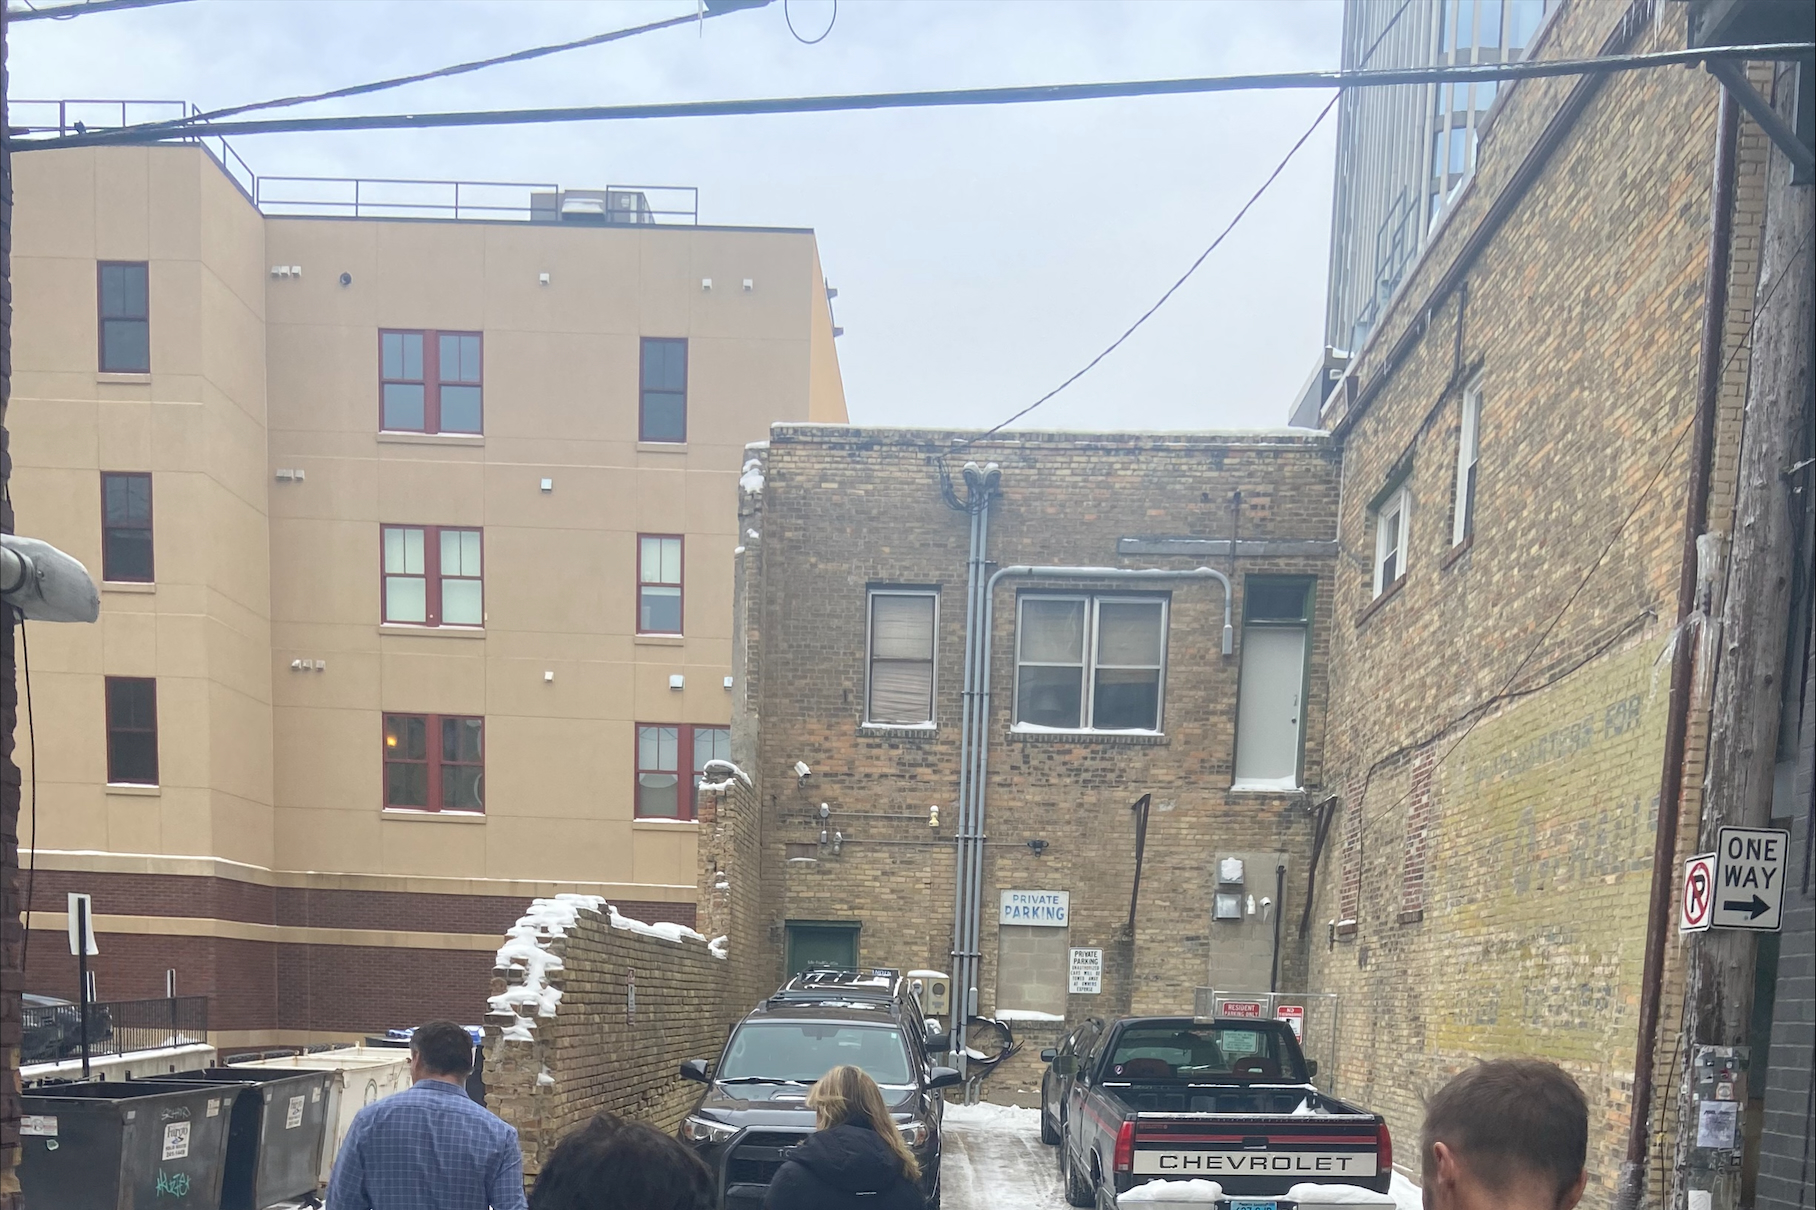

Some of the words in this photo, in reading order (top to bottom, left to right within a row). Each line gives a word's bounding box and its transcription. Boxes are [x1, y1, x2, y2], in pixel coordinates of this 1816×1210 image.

[1604, 693, 1641, 740] FOR
[1728, 836, 1778, 862] ONE
[1725, 864, 1778, 889] WAY
[1012, 894, 1059, 905] PRIVATE
[1004, 905, 1065, 921] PARKING
[1073, 958, 1099, 966] PARKING
[1227, 1004, 1255, 1012] RESIDENT
[1159, 1155, 1353, 1171] CHEVROLET
